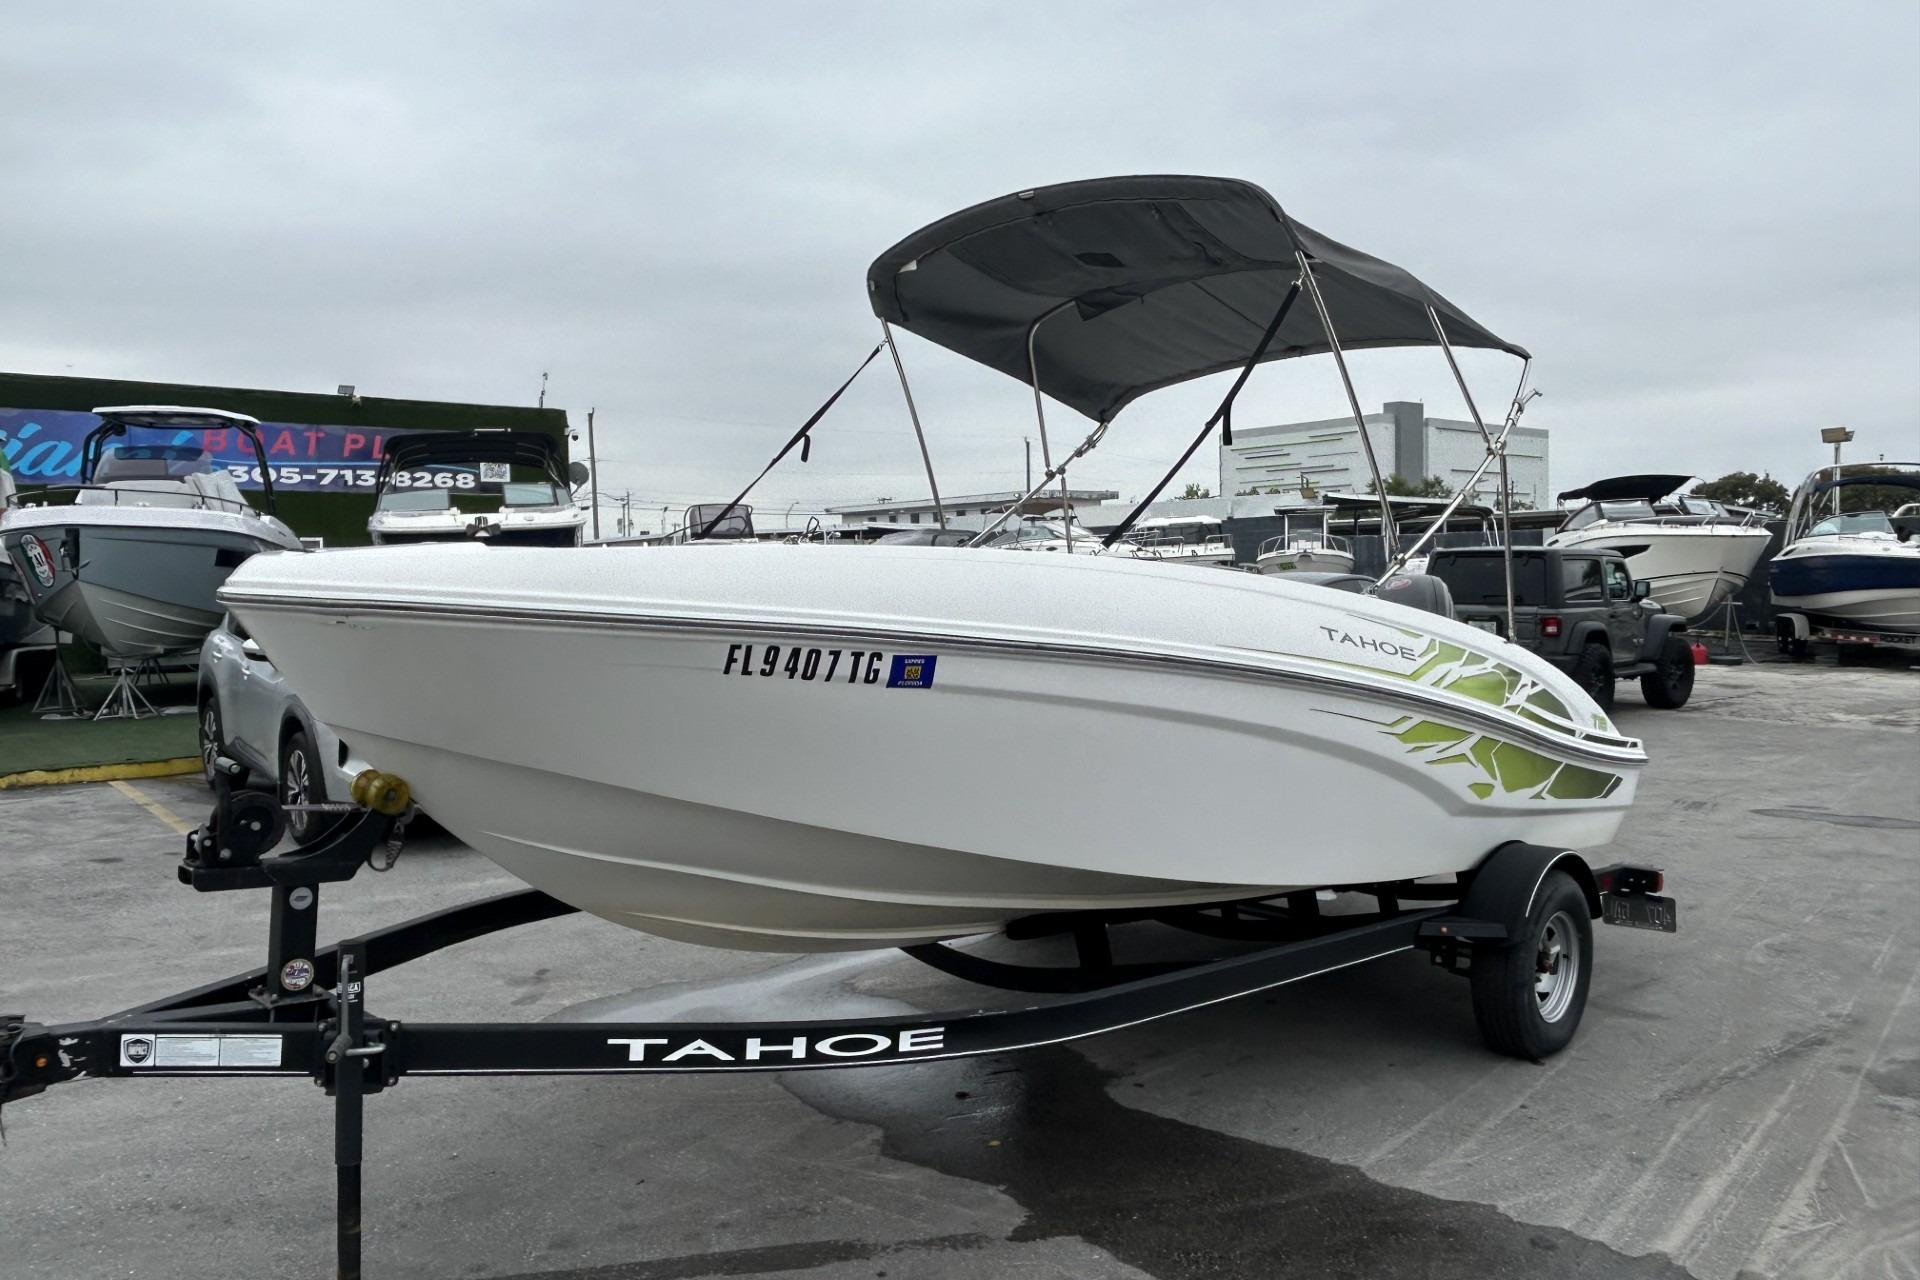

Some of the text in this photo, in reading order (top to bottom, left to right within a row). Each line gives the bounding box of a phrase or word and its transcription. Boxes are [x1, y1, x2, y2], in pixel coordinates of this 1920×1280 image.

[203, 427, 325, 457] BOAT
[227, 463, 476, 489] 305-713-8268
[1320, 626, 1416, 661] TAHOE
[723, 644, 753, 676] FL
[760, 645, 842, 682] 9407
[848, 651, 883, 684] TG
[607, 1027, 945, 1062] TAHOE
